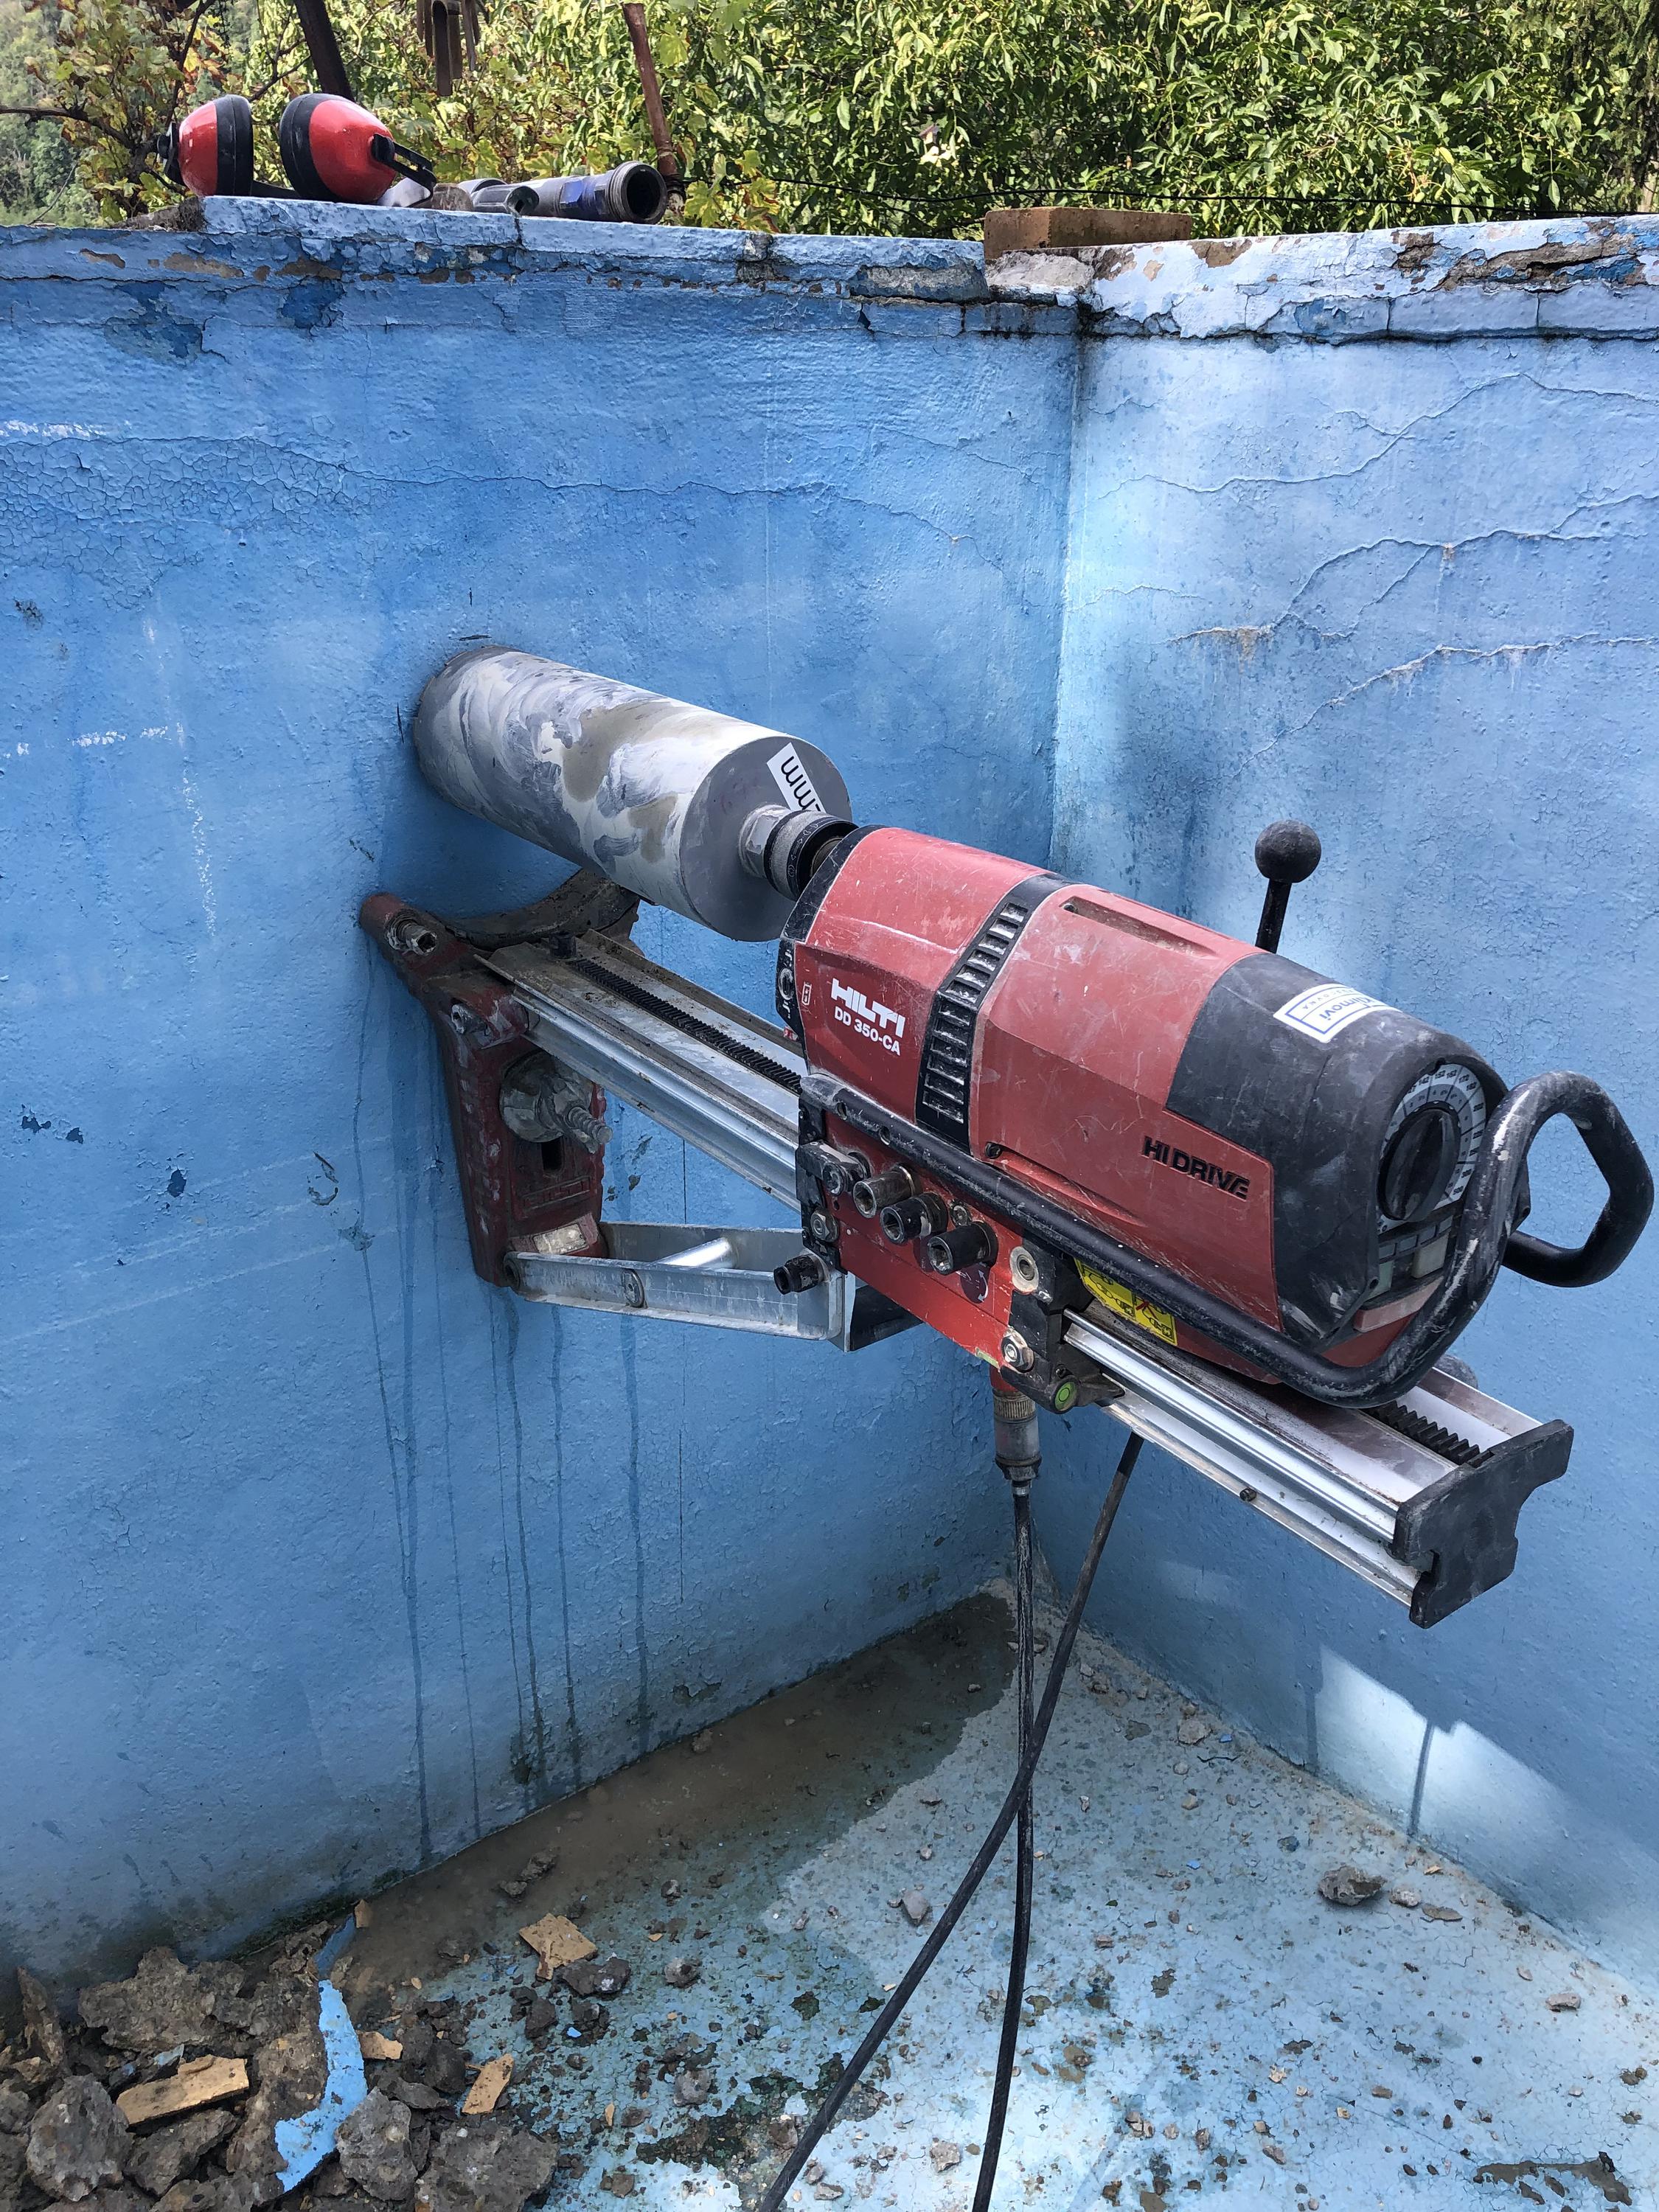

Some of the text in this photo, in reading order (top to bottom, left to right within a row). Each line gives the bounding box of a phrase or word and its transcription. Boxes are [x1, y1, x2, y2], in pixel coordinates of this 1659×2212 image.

[781, 756, 821, 812] mm
[830, 977, 906, 1038] HILTI
[834, 1006, 902, 1056] DD 350-CA
[1142, 1135, 1251, 1201] HI DRIVE
